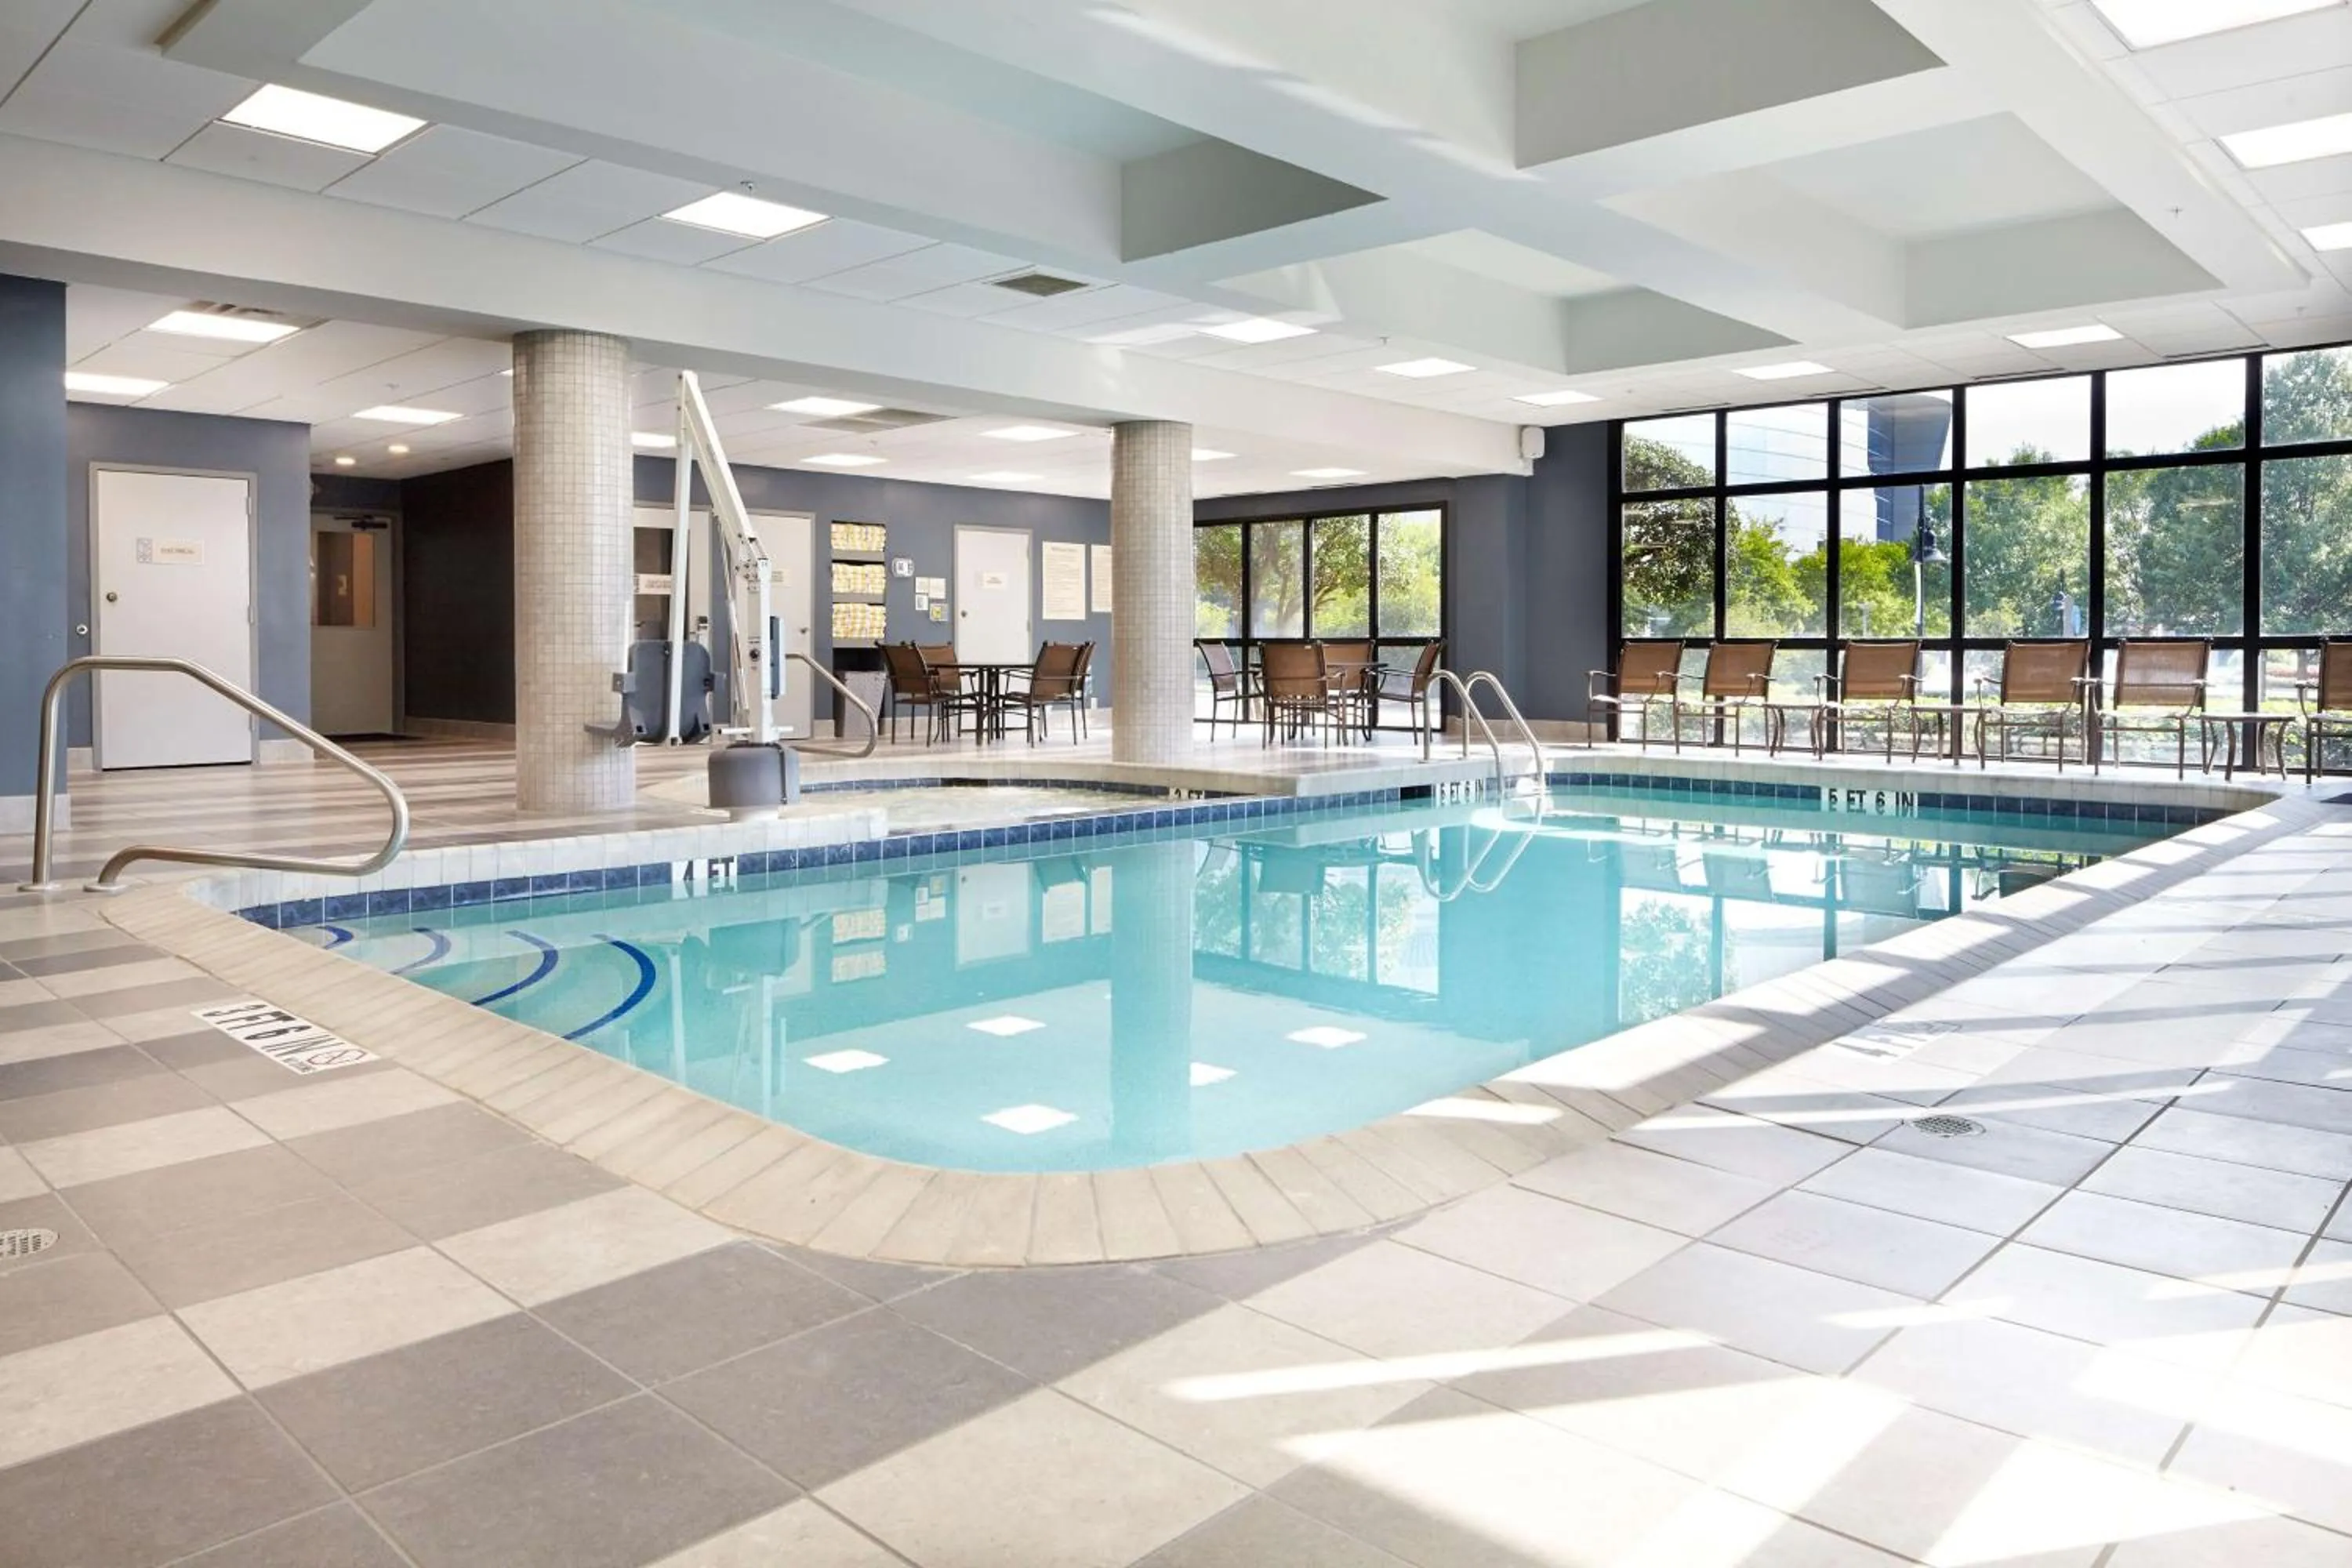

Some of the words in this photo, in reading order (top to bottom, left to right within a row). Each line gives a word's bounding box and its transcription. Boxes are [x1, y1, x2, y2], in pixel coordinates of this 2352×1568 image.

[1846, 789, 1866, 805] FT
[1876, 791, 1886, 808] 6
[1896, 792, 1914, 807] IN
[708, 856, 735, 879] FT
[201, 1004, 267, 1017] 3
[216, 1011, 296, 1031] FT
[243, 1025, 312, 1040] 6
[260, 1034, 345, 1058] IN
